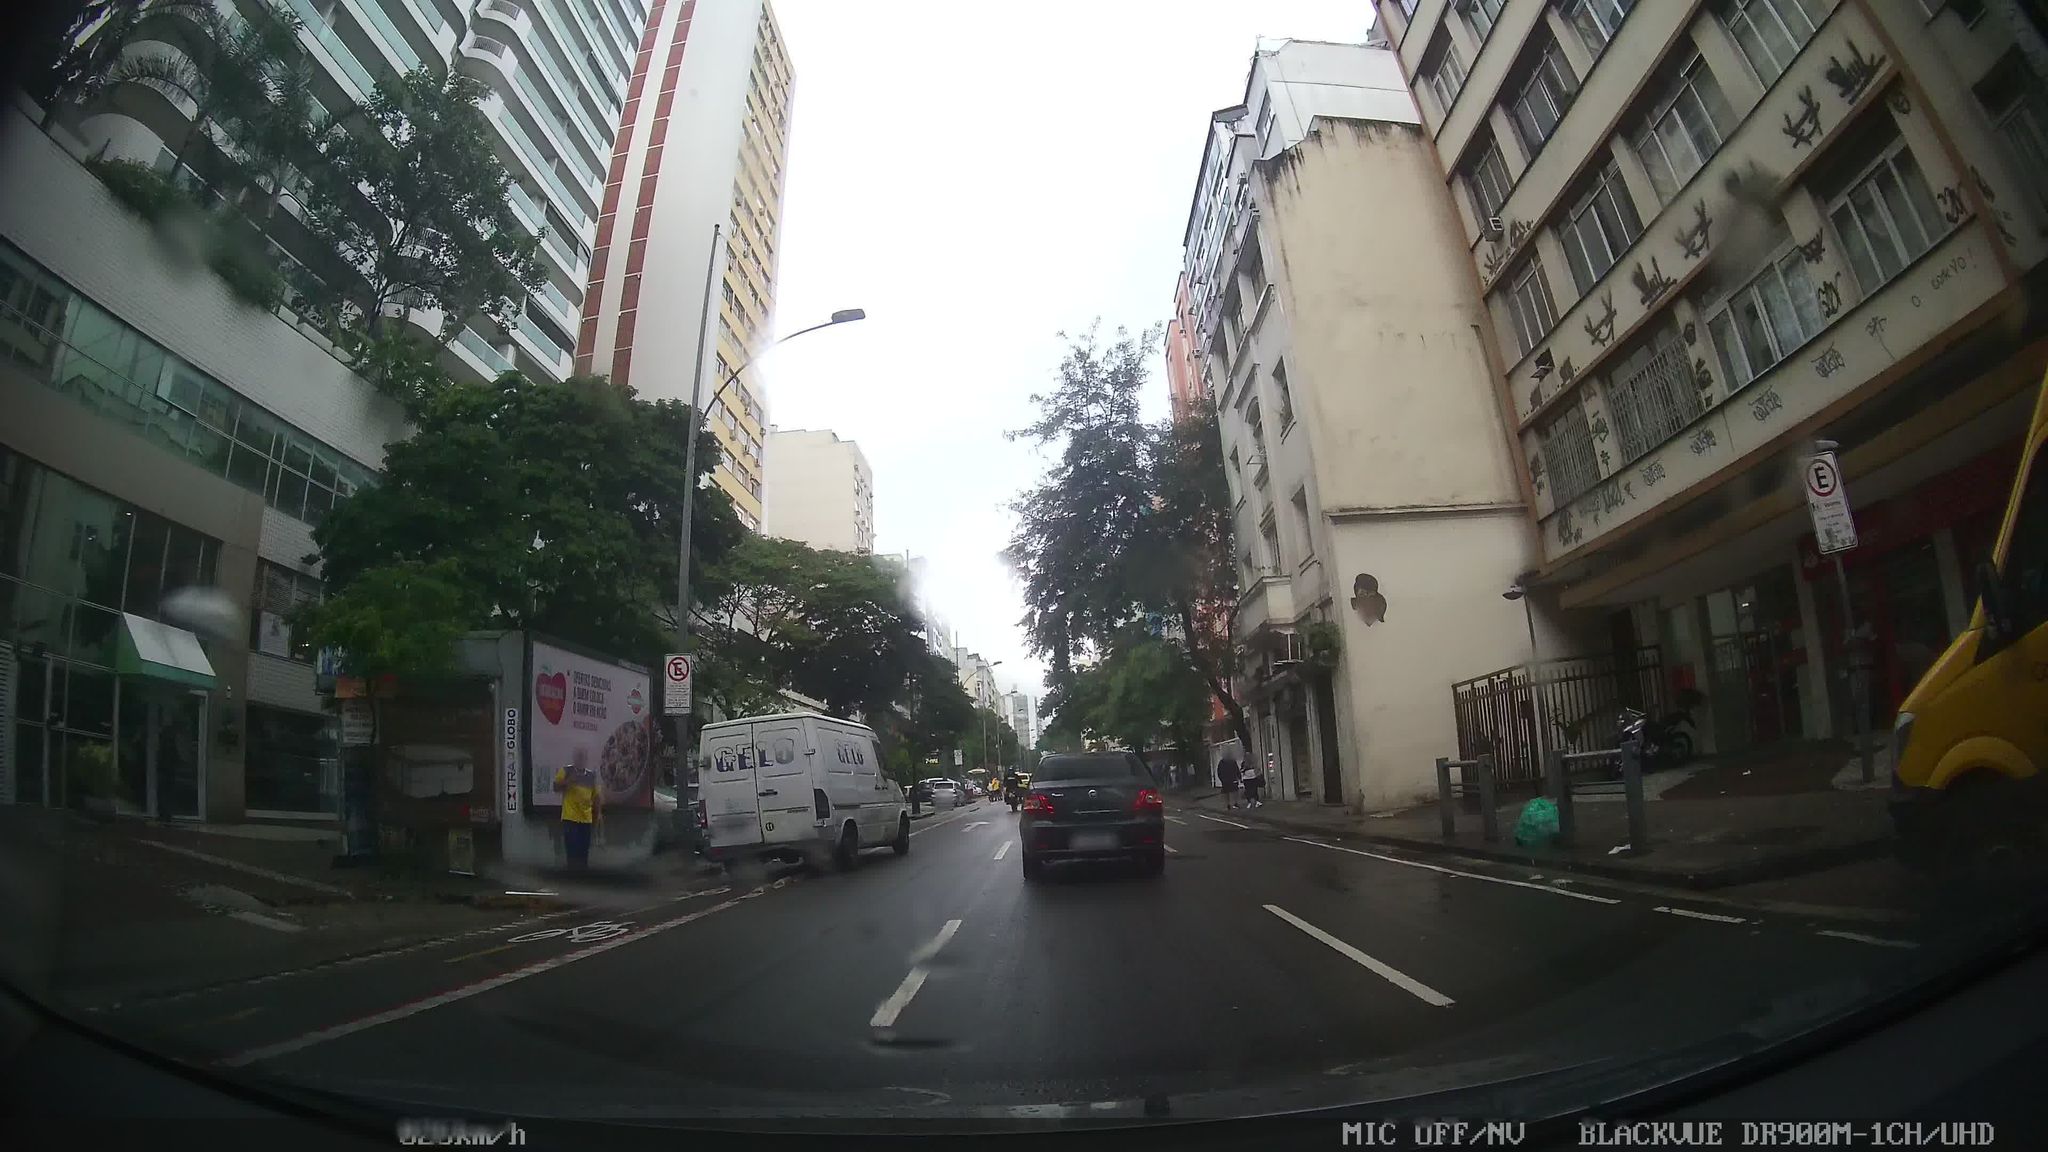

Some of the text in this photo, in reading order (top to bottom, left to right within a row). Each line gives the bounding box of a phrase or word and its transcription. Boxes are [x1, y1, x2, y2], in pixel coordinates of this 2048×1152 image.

[1814, 466, 1829, 489] E
[674, 662, 682, 676] E
[507, 709, 516, 749] GLOBO
[714, 737, 795, 773] GELO
[507, 761, 516, 811] EXTRA
